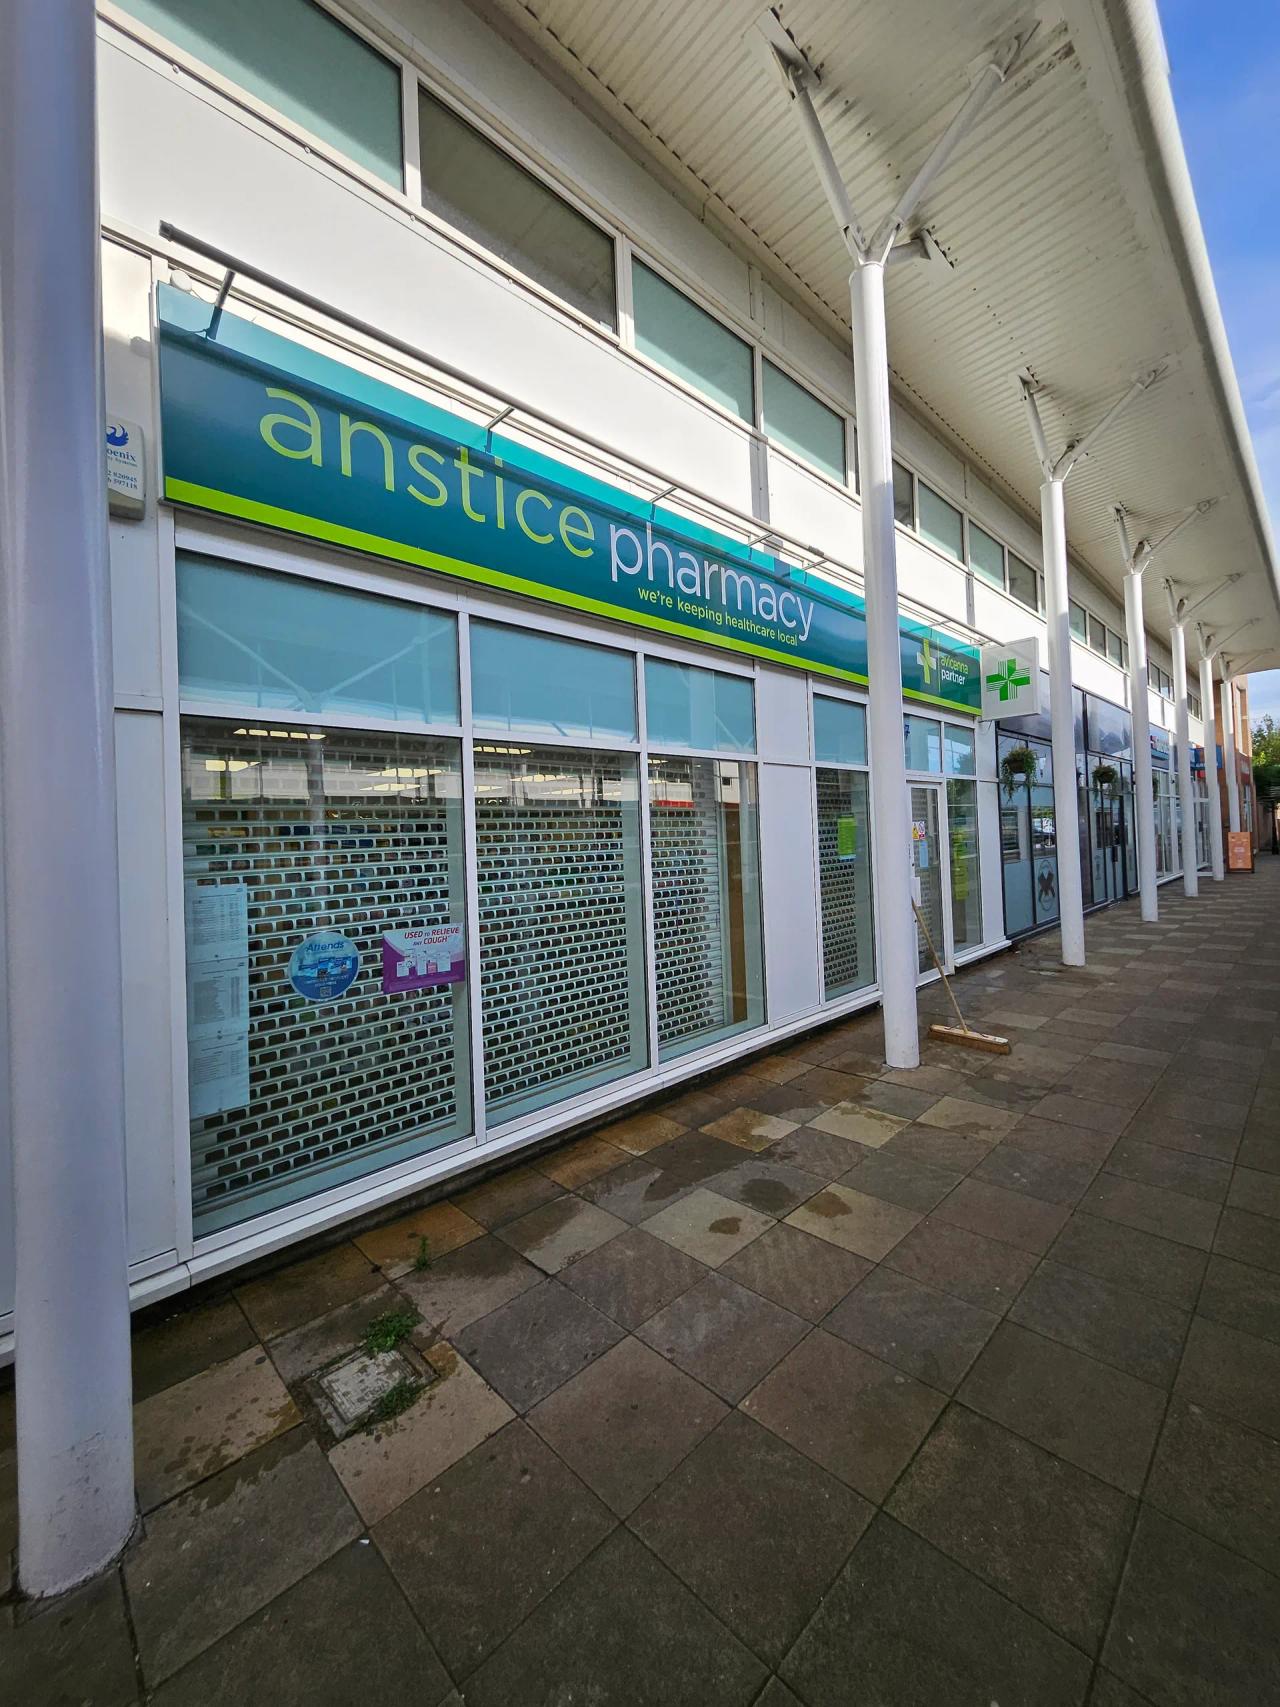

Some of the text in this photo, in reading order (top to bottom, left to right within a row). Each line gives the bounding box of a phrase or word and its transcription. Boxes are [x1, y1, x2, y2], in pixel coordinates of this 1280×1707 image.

[106, 449, 136, 462] oenix
[259, 387, 814, 642] anstice pharmacy
[638, 587, 798, 647] we're keeping healthcare local
[941, 655, 968, 675] avicenna
[941, 669, 966, 685] partner
[404, 930, 424, 939] USED
[431, 926, 460, 936] RELIEVE
